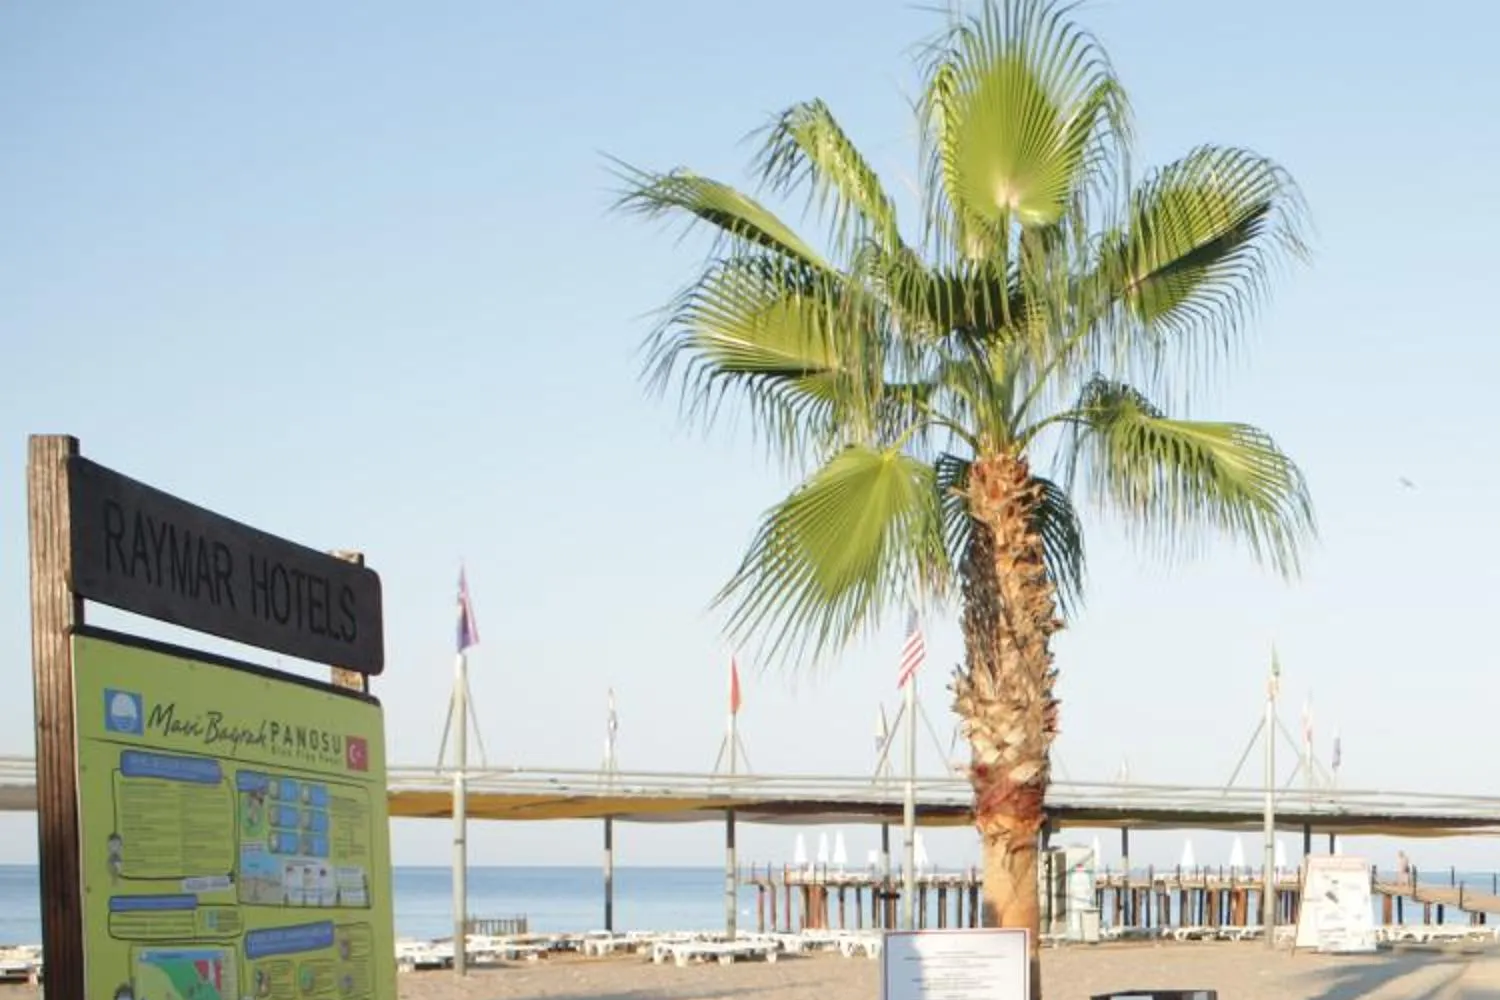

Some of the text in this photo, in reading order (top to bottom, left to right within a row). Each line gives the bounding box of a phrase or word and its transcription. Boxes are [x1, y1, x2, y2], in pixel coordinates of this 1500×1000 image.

[103, 498, 357, 643] RAYMAR HOTELS
[270, 721, 342, 755] PANOSU
